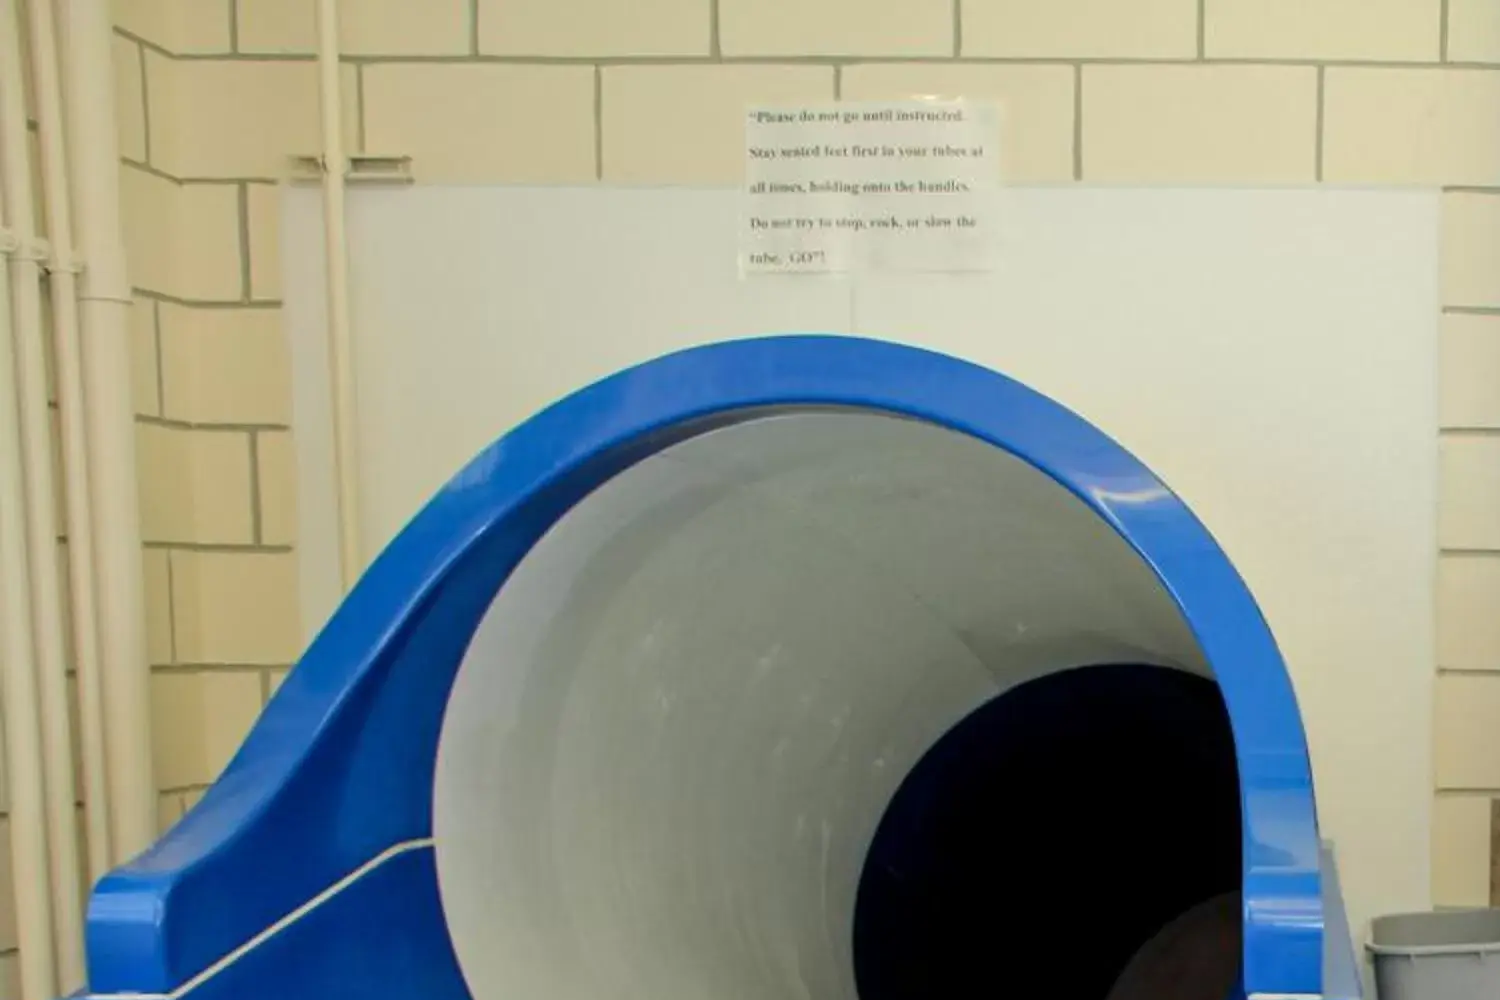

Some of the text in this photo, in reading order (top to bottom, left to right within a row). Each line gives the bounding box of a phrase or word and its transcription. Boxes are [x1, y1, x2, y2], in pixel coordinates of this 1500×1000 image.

[799, 111, 815, 121] do
[819, 112, 839, 121] not
[844, 113, 858, 124] go
[863, 111, 892, 121] until
[749, 147, 776, 158] Stay
[825, 146, 847, 156] feet
[852, 146, 877, 156] first
[882, 146, 894, 156] in
[898, 148, 927, 158] your
[750, 182, 765, 193] all
[809, 181, 859, 196] holding
[863, 183, 890, 193] onto
[895, 181, 913, 193] the
[751, 218, 768, 229] Do
[771, 219, 791, 229] not
[796, 218, 814, 230] try
[819, 218, 832, 228] to
[907, 220, 920, 228] or
[925, 216, 951, 228] slow
[957, 216, 977, 228] the
